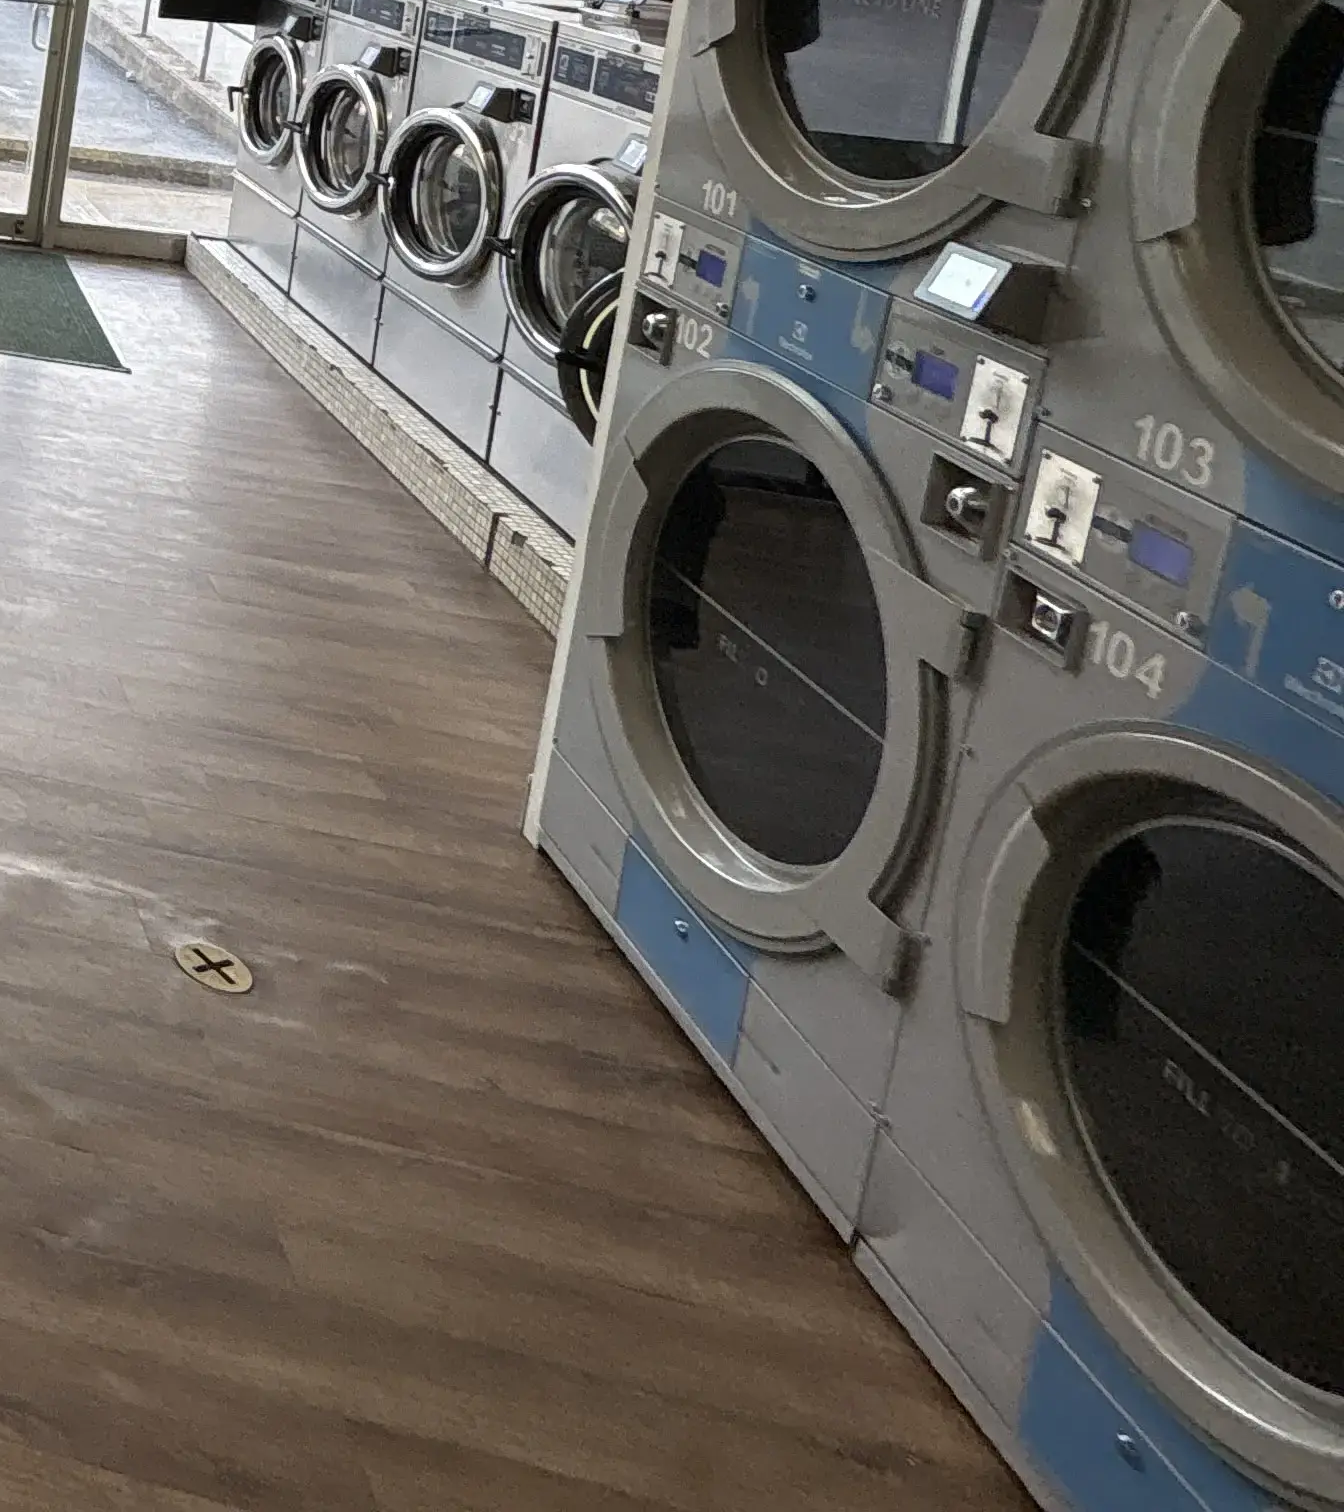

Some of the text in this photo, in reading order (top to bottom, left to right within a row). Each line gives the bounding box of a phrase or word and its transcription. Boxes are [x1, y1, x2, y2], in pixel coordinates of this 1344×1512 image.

[702, 178, 738, 218] 101
[675, 312, 714, 360] 102
[1133, 414, 1215, 487] 103
[1088, 620, 1167, 700] 104
